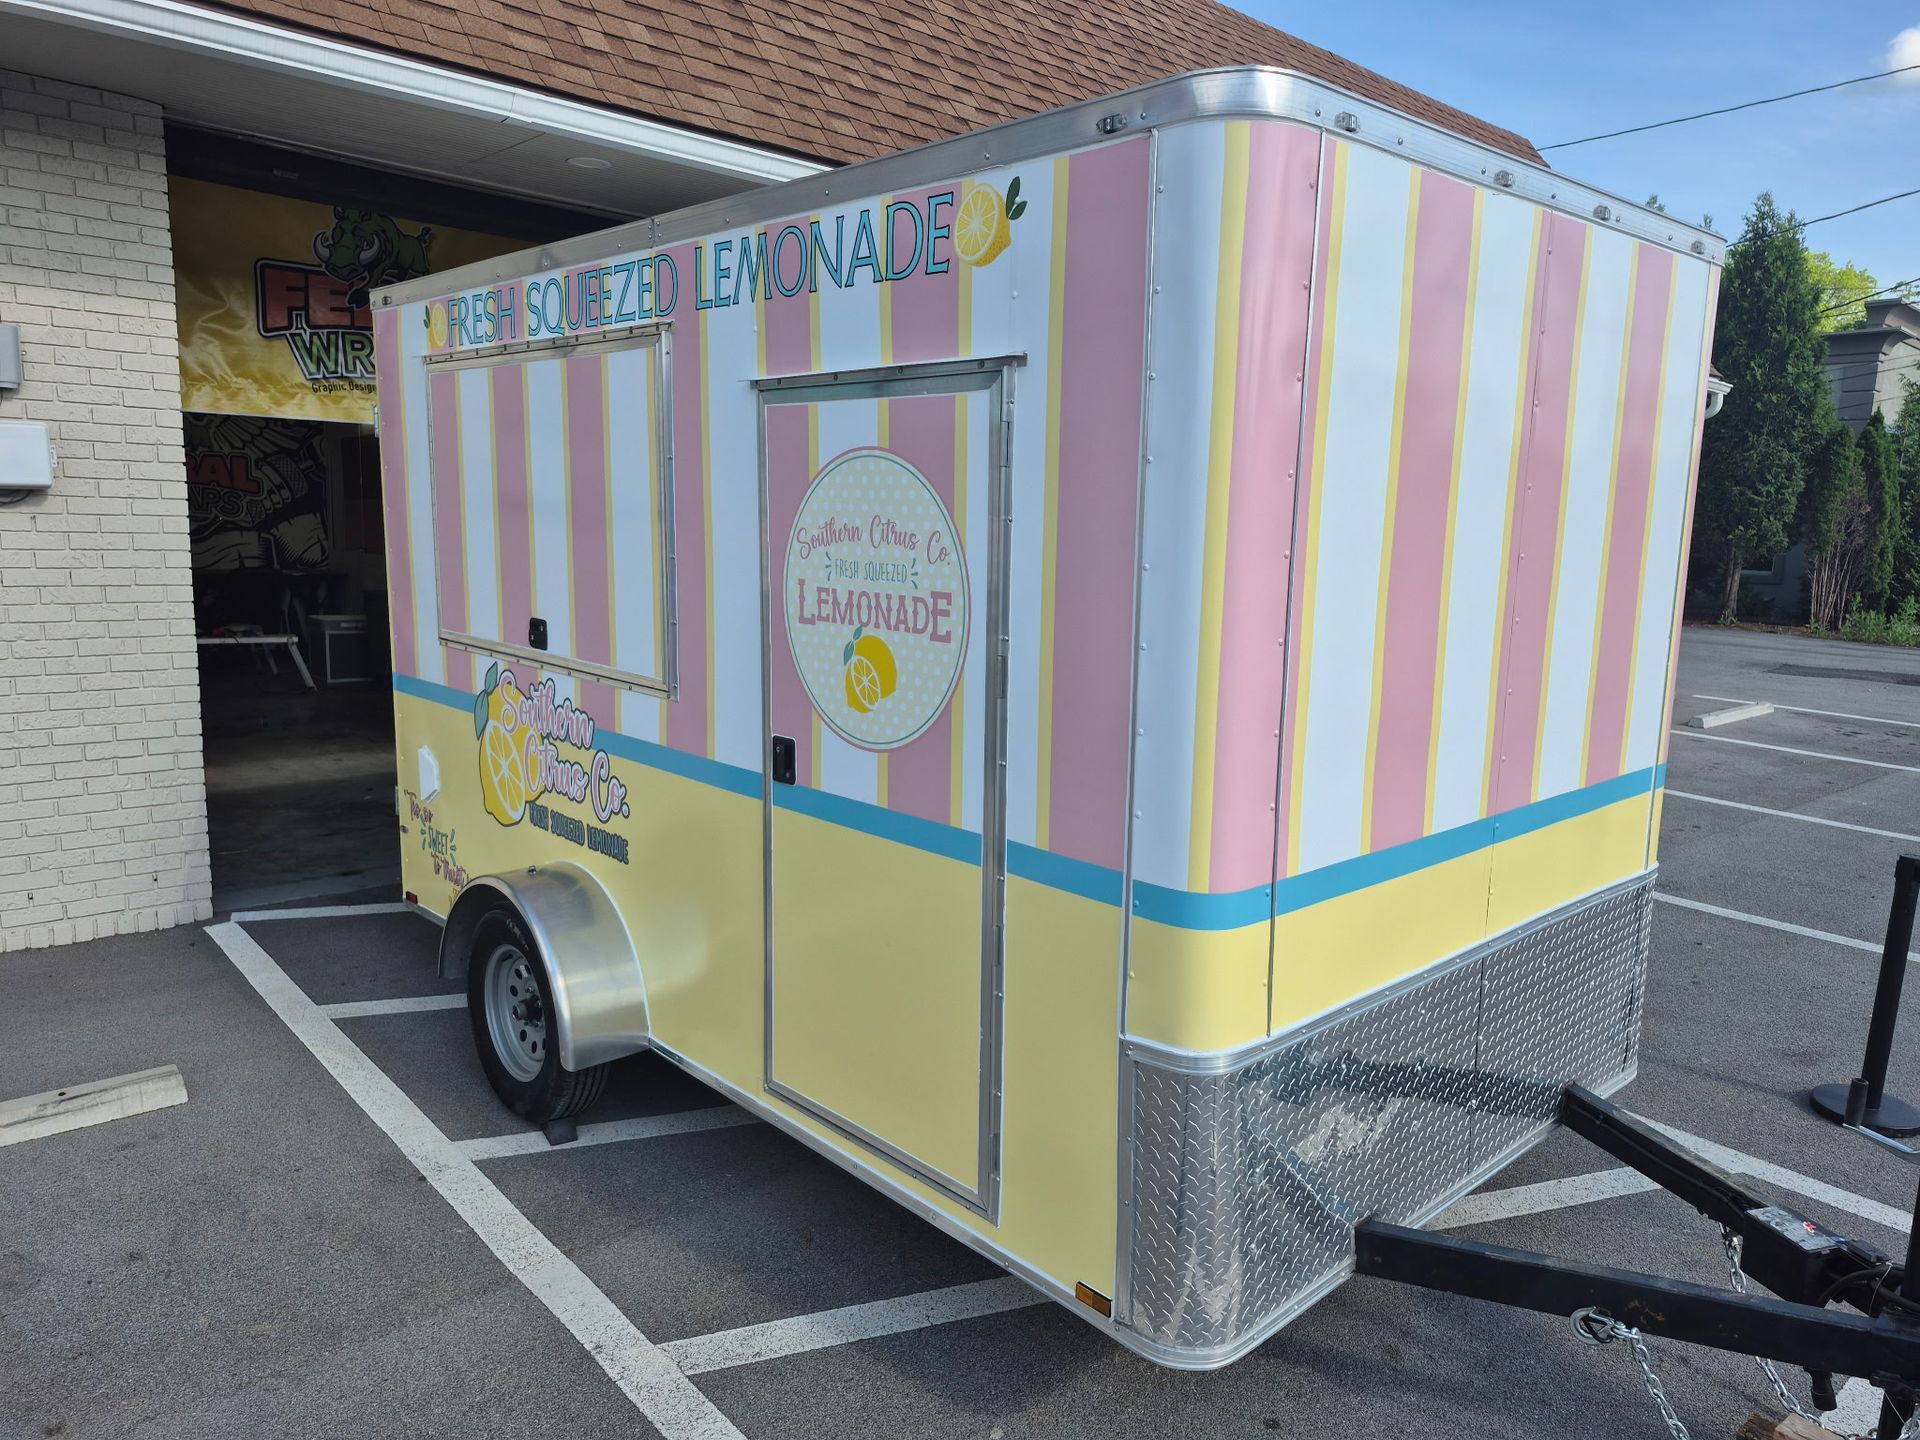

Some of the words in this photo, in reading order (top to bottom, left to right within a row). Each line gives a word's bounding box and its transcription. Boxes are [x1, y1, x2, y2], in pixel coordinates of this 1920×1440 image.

[447, 287, 515, 347] FRESH
[526, 253, 678, 337] SQUEEZED
[695, 192, 954, 310] LEMONADE
[312, 382, 346, 395] Graphic
[797, 517, 863, 559] Southern
[870, 514, 919, 550] Citrus
[927, 530, 951, 566] Co.
[834, 558, 859, 580] FRESH
[863, 560, 908, 584] SQUEEZED
[798, 578, 953, 643] LEMONADE
[500, 670, 595, 749] Southern
[524, 730, 589, 803] Citrus
[591, 749, 630, 823] Co.
[428, 825, 449, 856] SWEET
[529, 801, 549, 832] FRESH
[550, 808, 586, 847] SQUEEZED
[587, 823, 630, 865] LEMONADE
